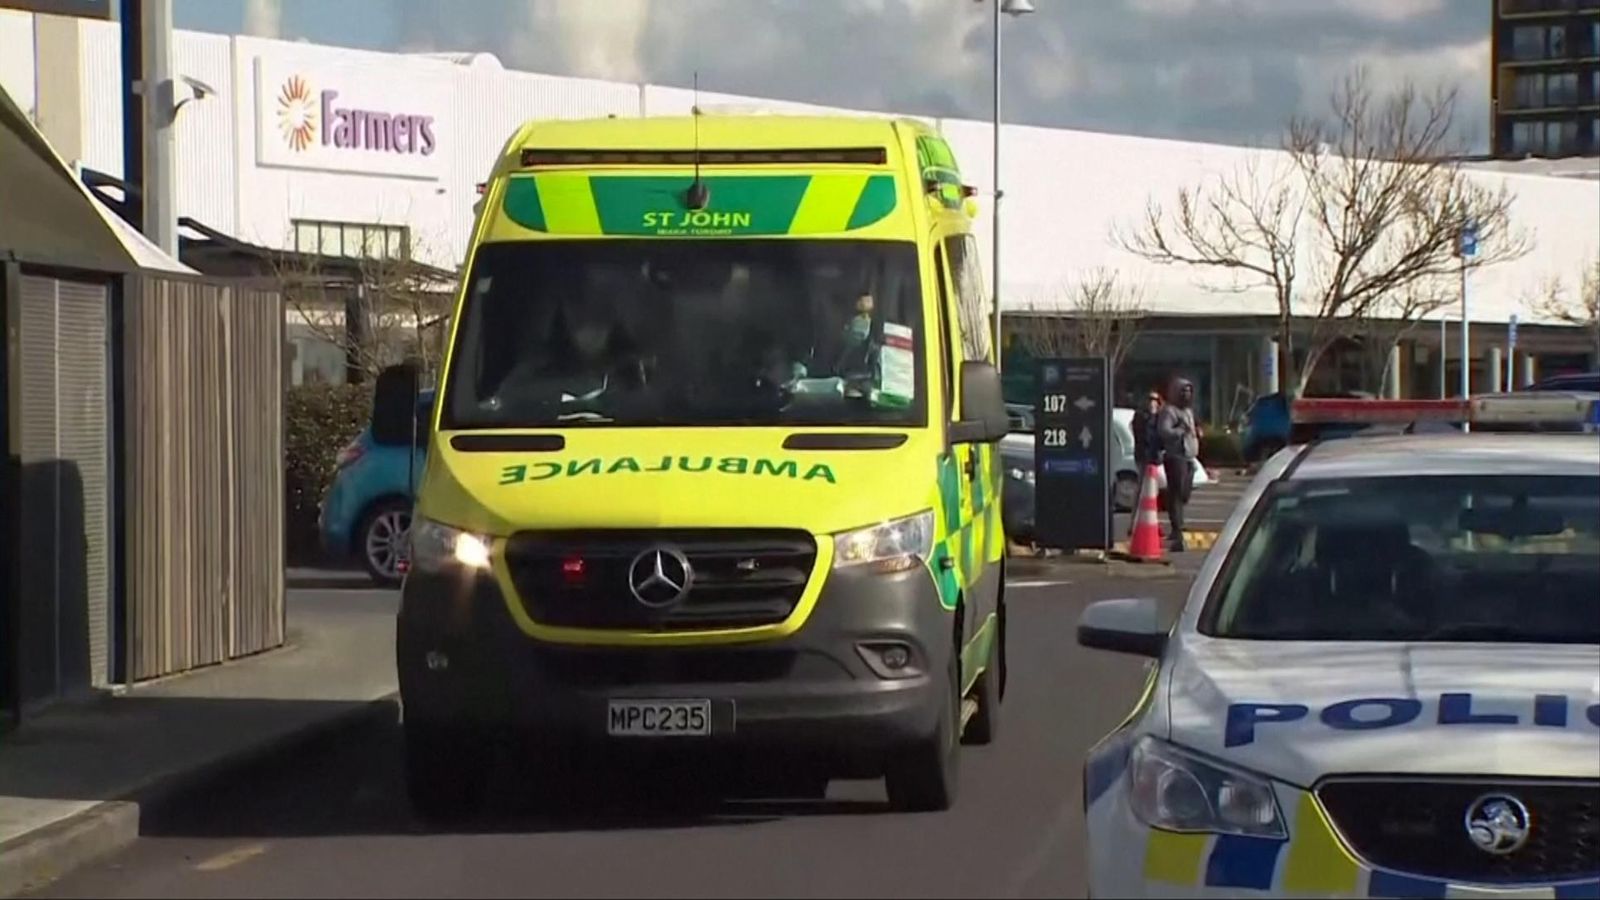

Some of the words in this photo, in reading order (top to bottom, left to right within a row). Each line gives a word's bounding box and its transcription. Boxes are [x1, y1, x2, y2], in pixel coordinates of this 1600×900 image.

[321, 89, 436, 155] Farmers
[643, 212, 675, 227] ST
[679, 212, 751, 227] JOHN
[1043, 395, 1066, 412] 107
[1044, 429, 1067, 446] 218
[611, 706, 704, 730] MPC235
[1225, 693, 1600, 748] POLI
